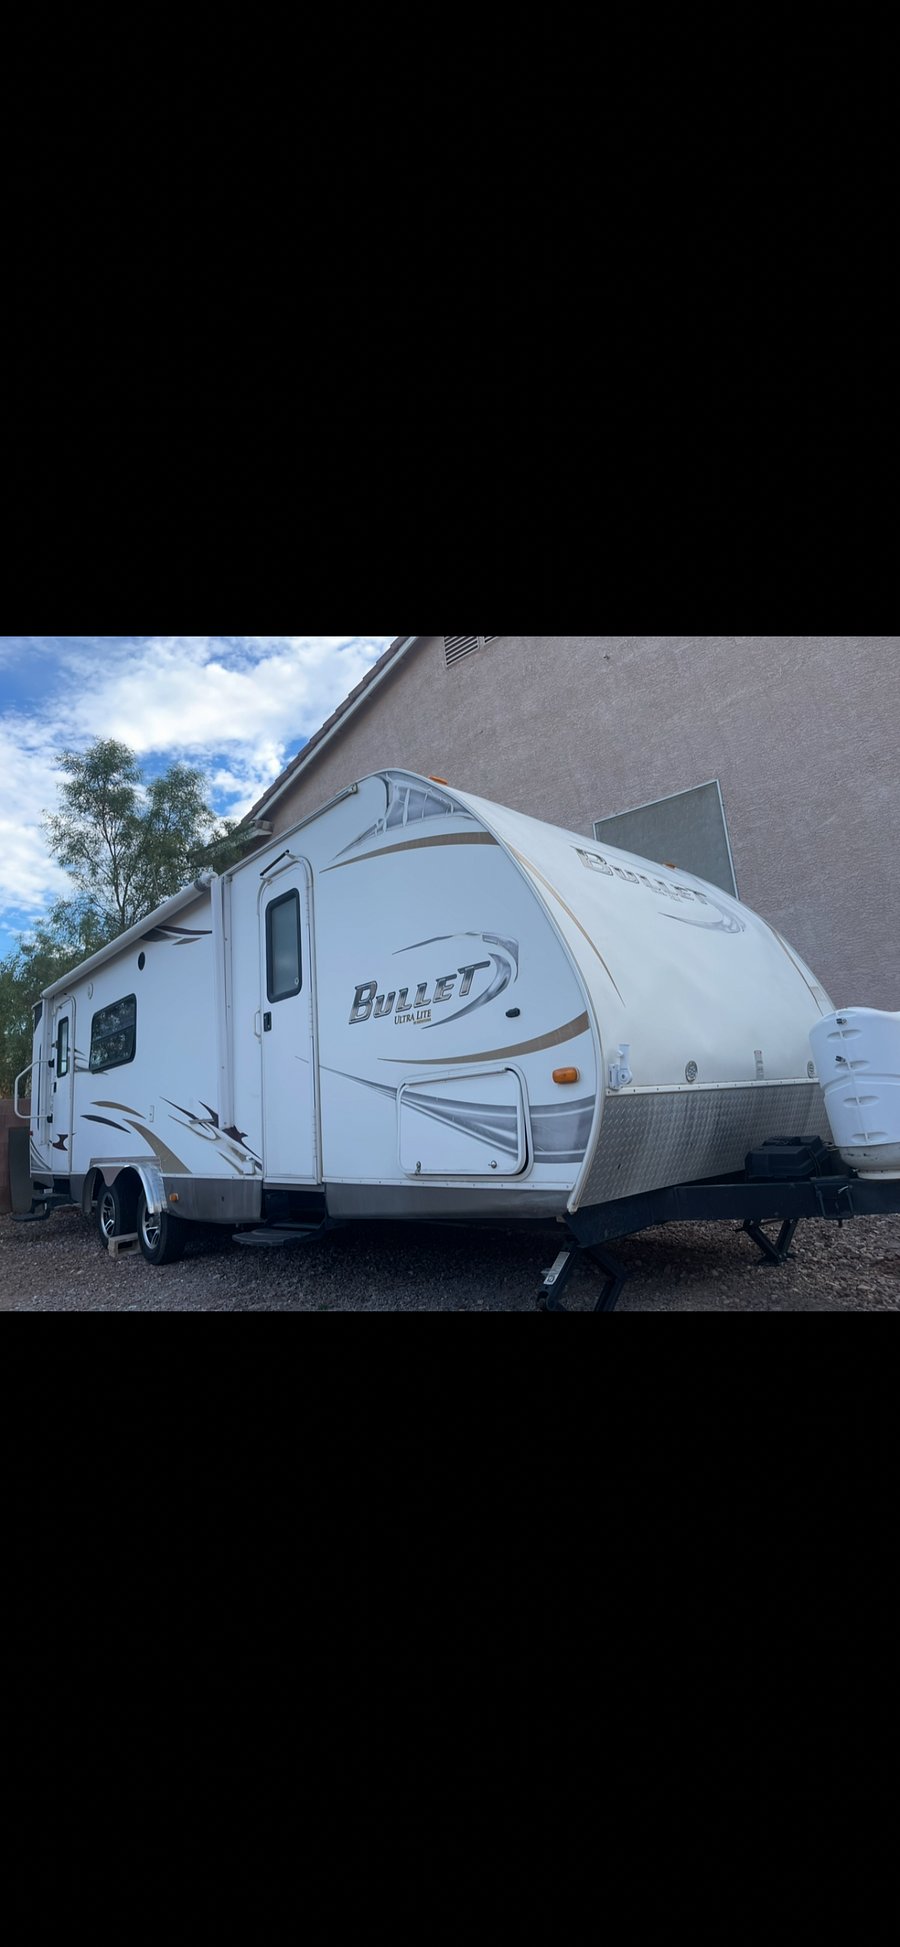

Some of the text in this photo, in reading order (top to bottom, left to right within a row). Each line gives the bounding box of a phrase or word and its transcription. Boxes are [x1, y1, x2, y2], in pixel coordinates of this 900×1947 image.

[574, 847, 708, 905] BULLET
[348, 960, 491, 1025] BULLET
[394, 1013, 415, 1025] ULTRA
[416, 1009, 431, 1020] LITE
